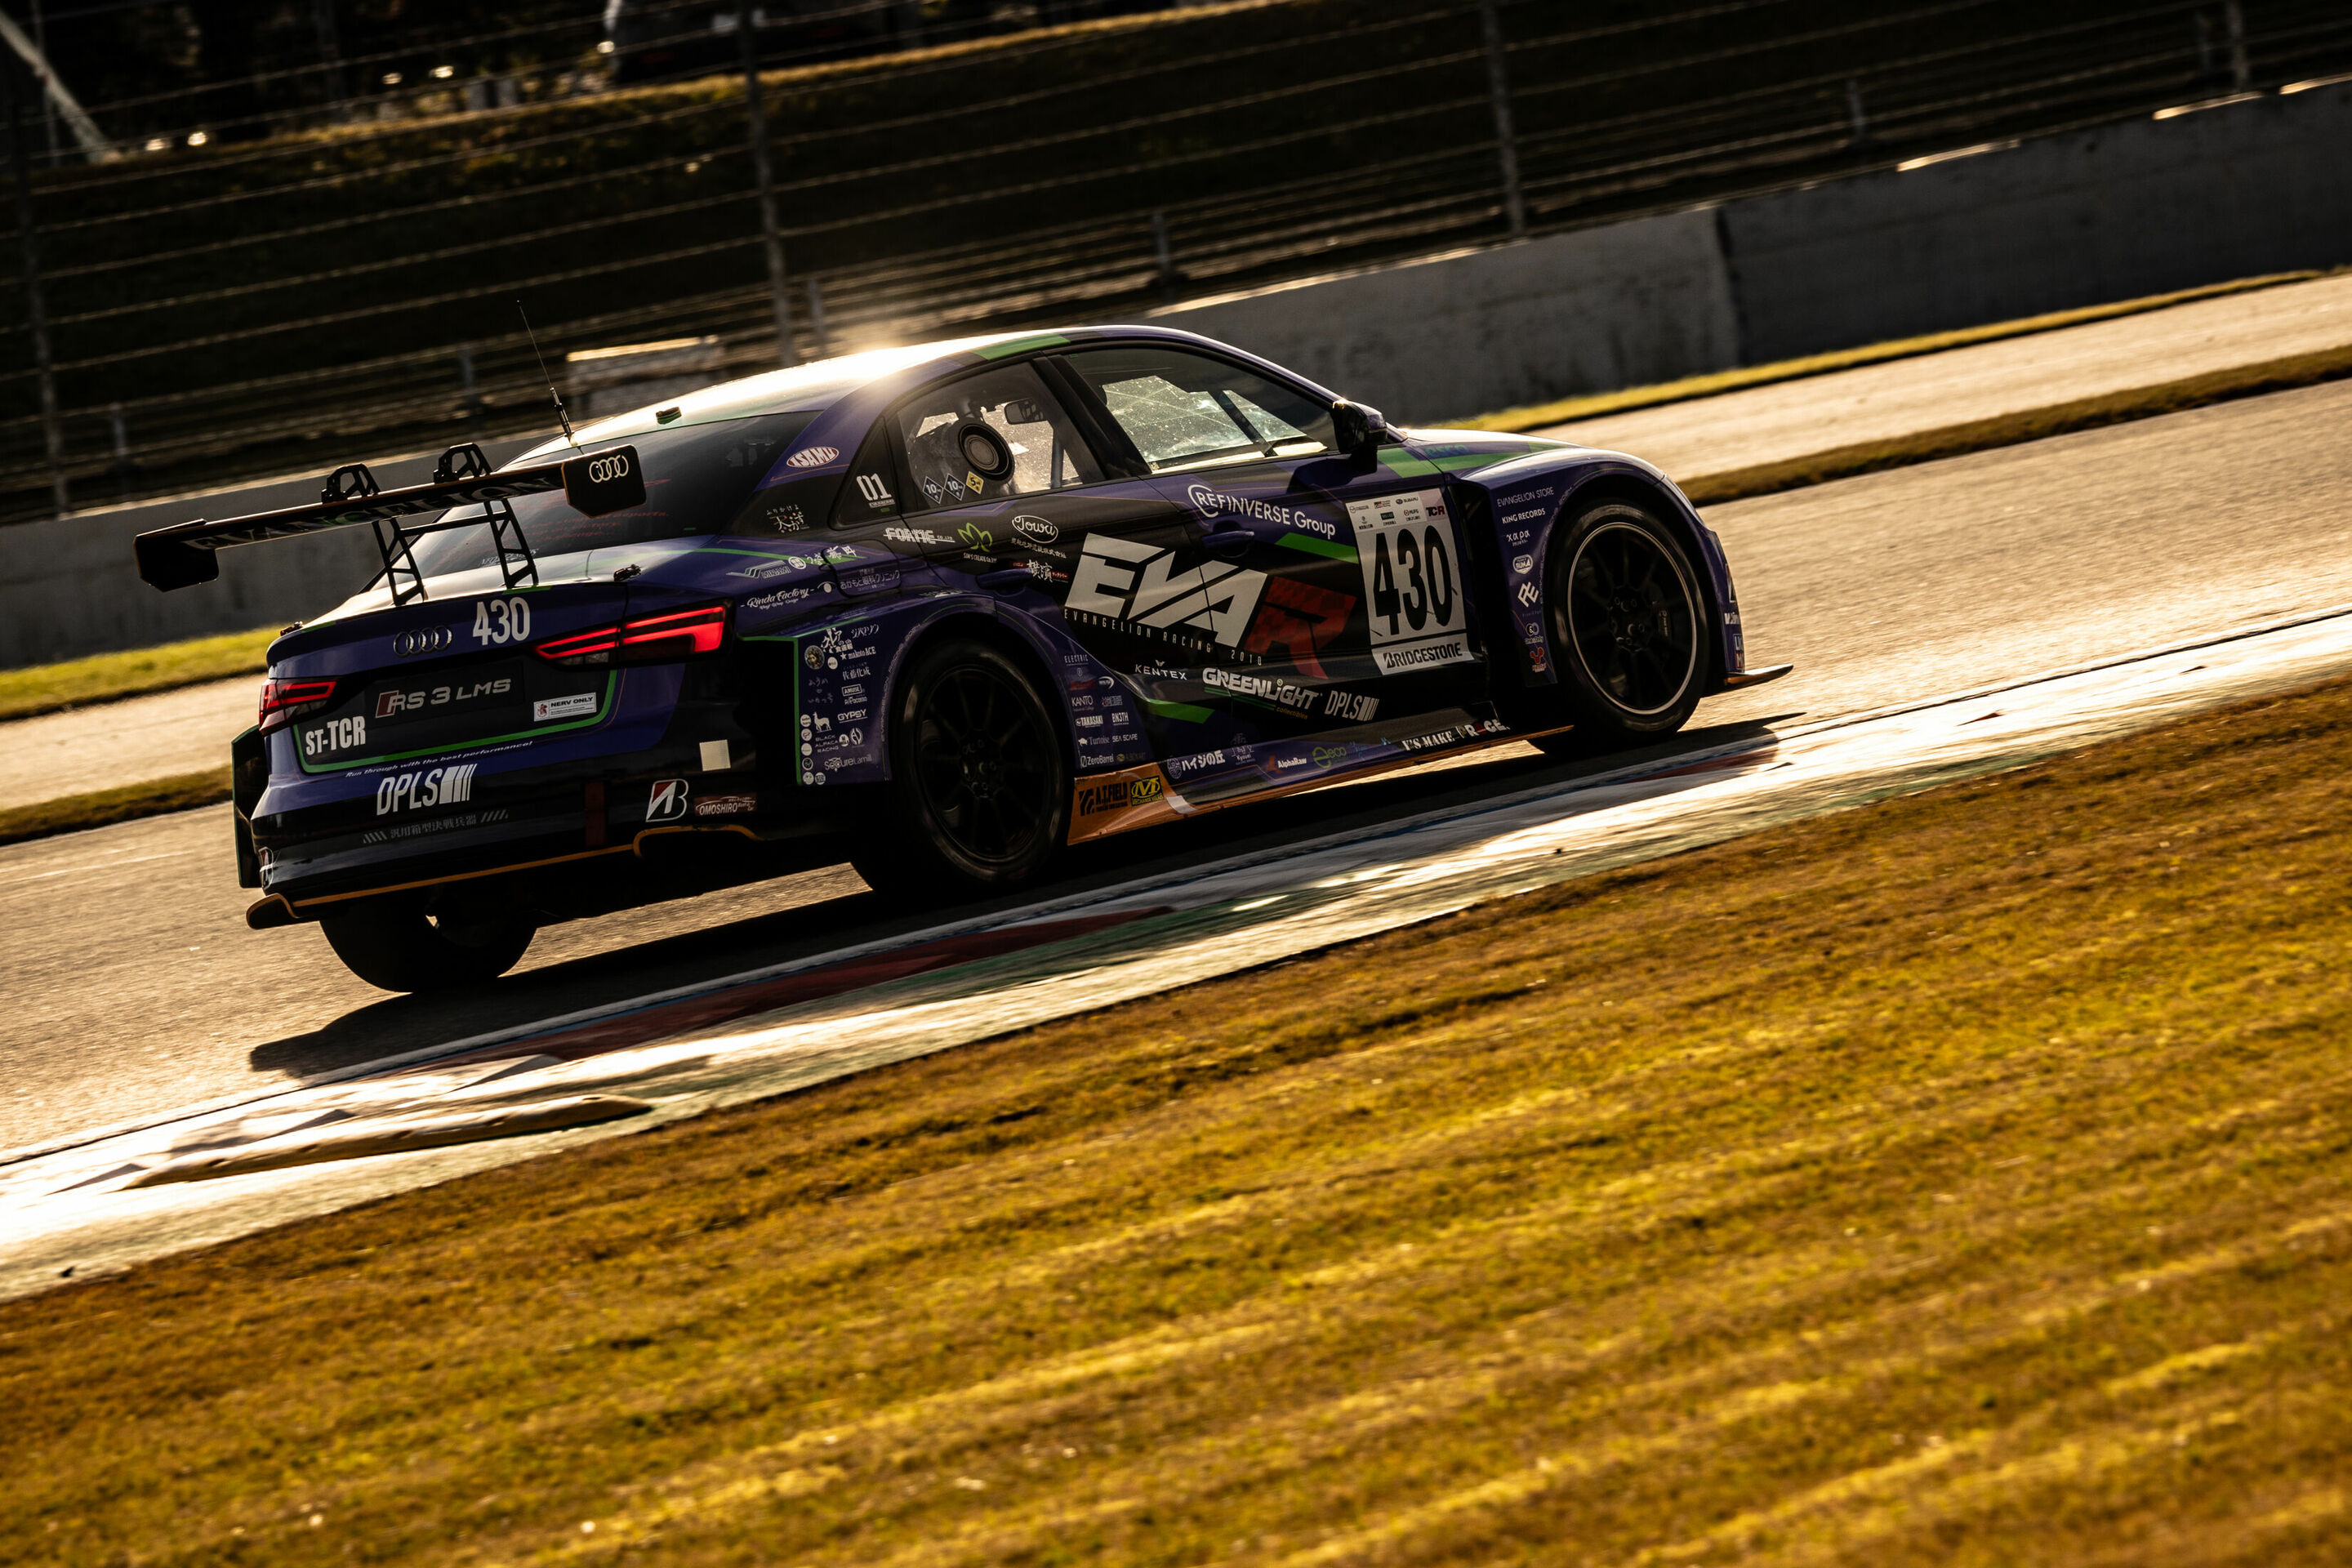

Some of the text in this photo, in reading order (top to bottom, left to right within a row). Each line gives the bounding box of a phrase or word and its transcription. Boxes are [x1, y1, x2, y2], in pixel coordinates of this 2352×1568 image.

[857, 473, 892, 501] 01
[1496, 487, 1554, 507] EVANGELION STORE
[1195, 491, 1336, 539] REFINVERSE Group
[1426, 506, 1445, 517] TCR
[1501, 508, 1546, 524] KING RECORDS
[1373, 525, 1452, 635] 430
[776, 588, 809, 602] Factory
[472, 596, 532, 646] 430
[1064, 608, 1152, 639] EVANGELION
[1163, 631, 1213, 653] RACING
[1064, 654, 1089, 663] ELECTRIC
[1383, 642, 1463, 668] BRIDGESTONE
[1134, 663, 1187, 680] KENTEX
[380, 679, 511, 716] RS 3 LMS
[1071, 695, 1094, 707] KANTO
[1324, 690, 1366, 721] DPLS
[837, 709, 867, 721] GYPSY
[305, 715, 366, 756] ST-TCR
[364, 764, 399, 775] through
[400, 760, 421, 768] with
[422, 756, 439, 764] the
[440, 752, 462, 761] best
[462, 741, 534, 759] performance!
[1183, 750, 1226, 771] ハイジの丘
[1277, 757, 1307, 768] AlphaRaw
[376, 765, 446, 816] DPLS
[699, 802, 738, 816] OMOSHIRO
